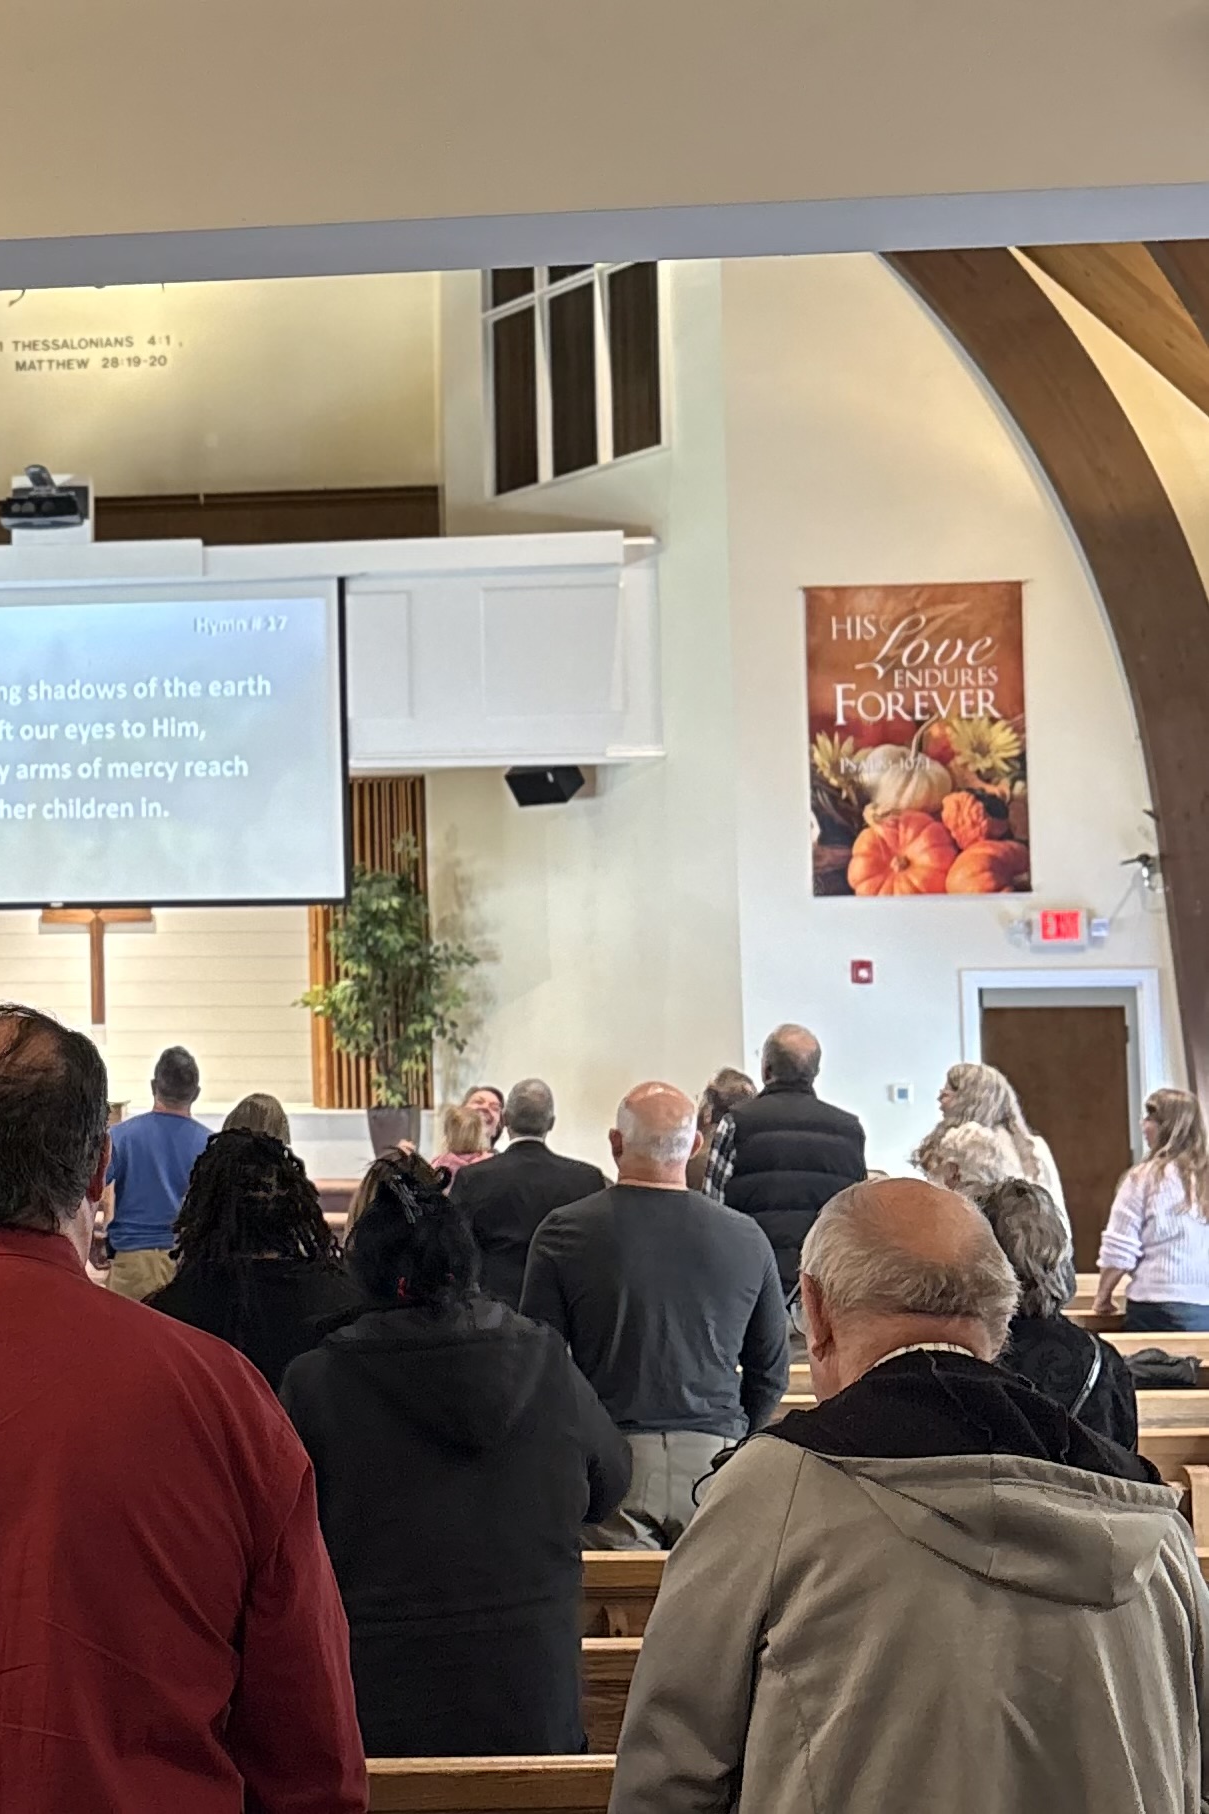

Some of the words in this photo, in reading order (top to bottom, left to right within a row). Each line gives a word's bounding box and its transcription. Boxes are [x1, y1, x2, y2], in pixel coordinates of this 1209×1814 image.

[12, 336, 134, 351] THESSALONIANS
[15, 358, 89, 372] MATTHEW
[102, 355, 167, 368] 28:19-20
[194, 617, 247, 636] Hymn
[268, 615, 287, 632] 17
[831, 616, 876, 640] HIS
[855, 614, 998, 680] Love
[27, 679, 127, 701] shadows
[133, 676, 158, 699] of
[164, 676, 201, 698] the
[209, 675, 271, 697] earth
[893, 666, 998, 689] ENDURES
[834, 684, 1001, 726] FOREVER
[20, 724, 57, 741] our
[64, 723, 115, 744] eyes
[122, 720, 146, 739] to
[152, 718, 207, 742] Him,
[16, 762, 72, 780] arms
[78, 757, 102, 779] of
[108, 760, 177, 783] mercy
[184, 756, 248, 778] reach
[42, 798, 134, 821] children
[141, 797, 170, 819] in.
